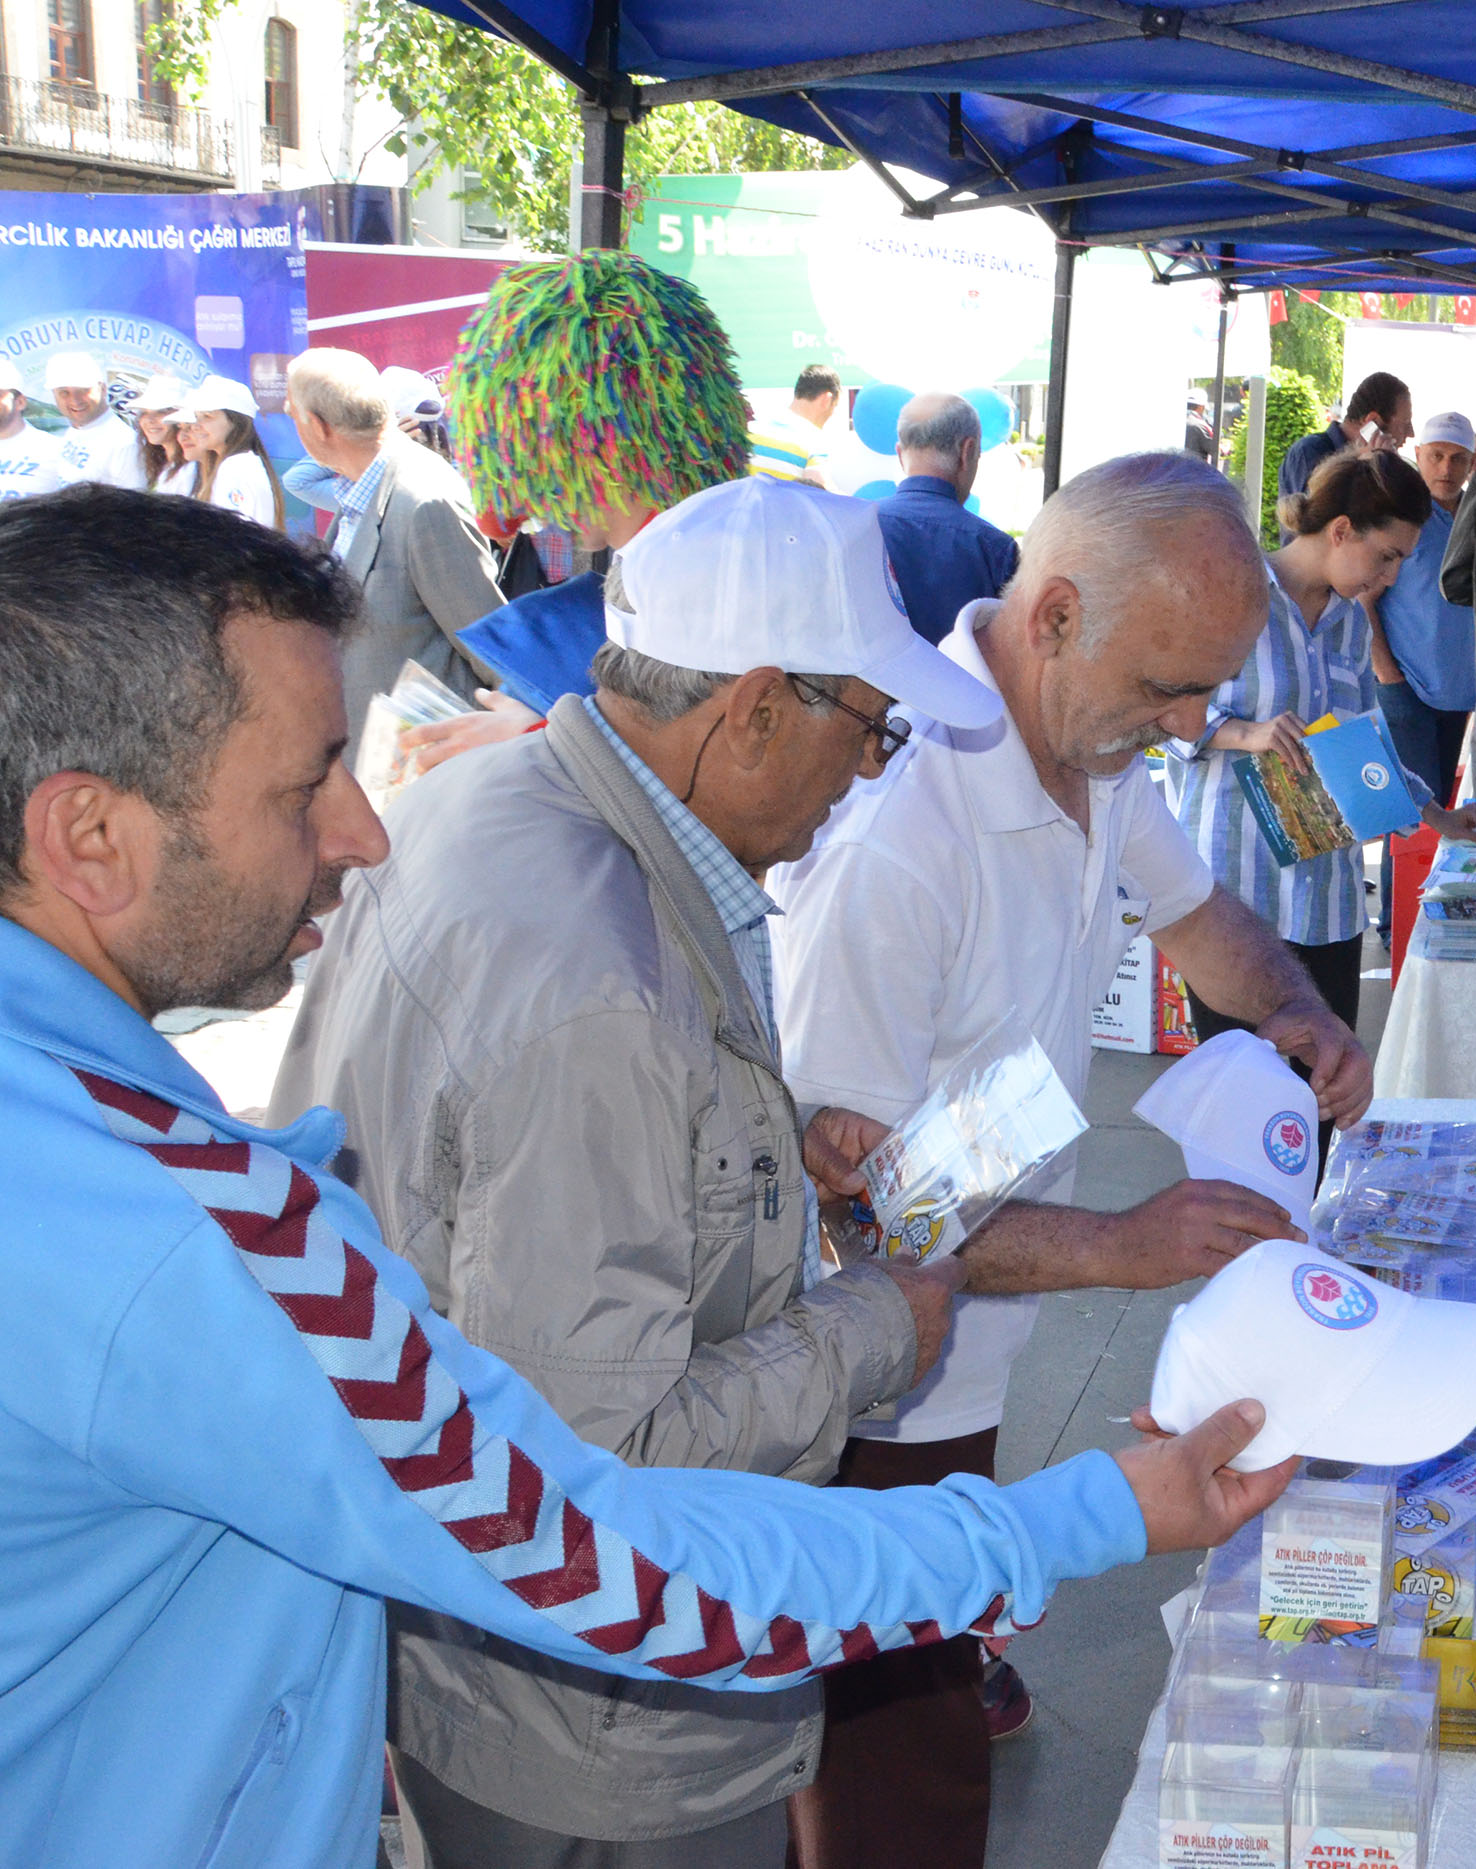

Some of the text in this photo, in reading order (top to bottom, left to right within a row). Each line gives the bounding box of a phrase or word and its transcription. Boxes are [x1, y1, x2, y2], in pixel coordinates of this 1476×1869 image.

[75, 225, 184, 250] BAKANLIĞI
[189, 224, 238, 253] ÇAĞRI
[241, 222, 291, 249] MERKEZİ
[658, 214, 685, 253] 5
[86, 318, 152, 350] CEVAP,
[160, 334, 193, 371] HER
[1275, 1546, 1368, 1567] ATIK PİLLER ÇÖP DEĞİLDİR.
[1401, 1576, 1445, 1596] TAP
[1306, 1596, 1321, 1607] için
[1322, 1599, 1338, 1608] geri
[1173, 1832, 1270, 1851] ATIK PİLLER ÇÖP DEĞİLDİR.
[1311, 1845, 1395, 1860] ATIK PİL
